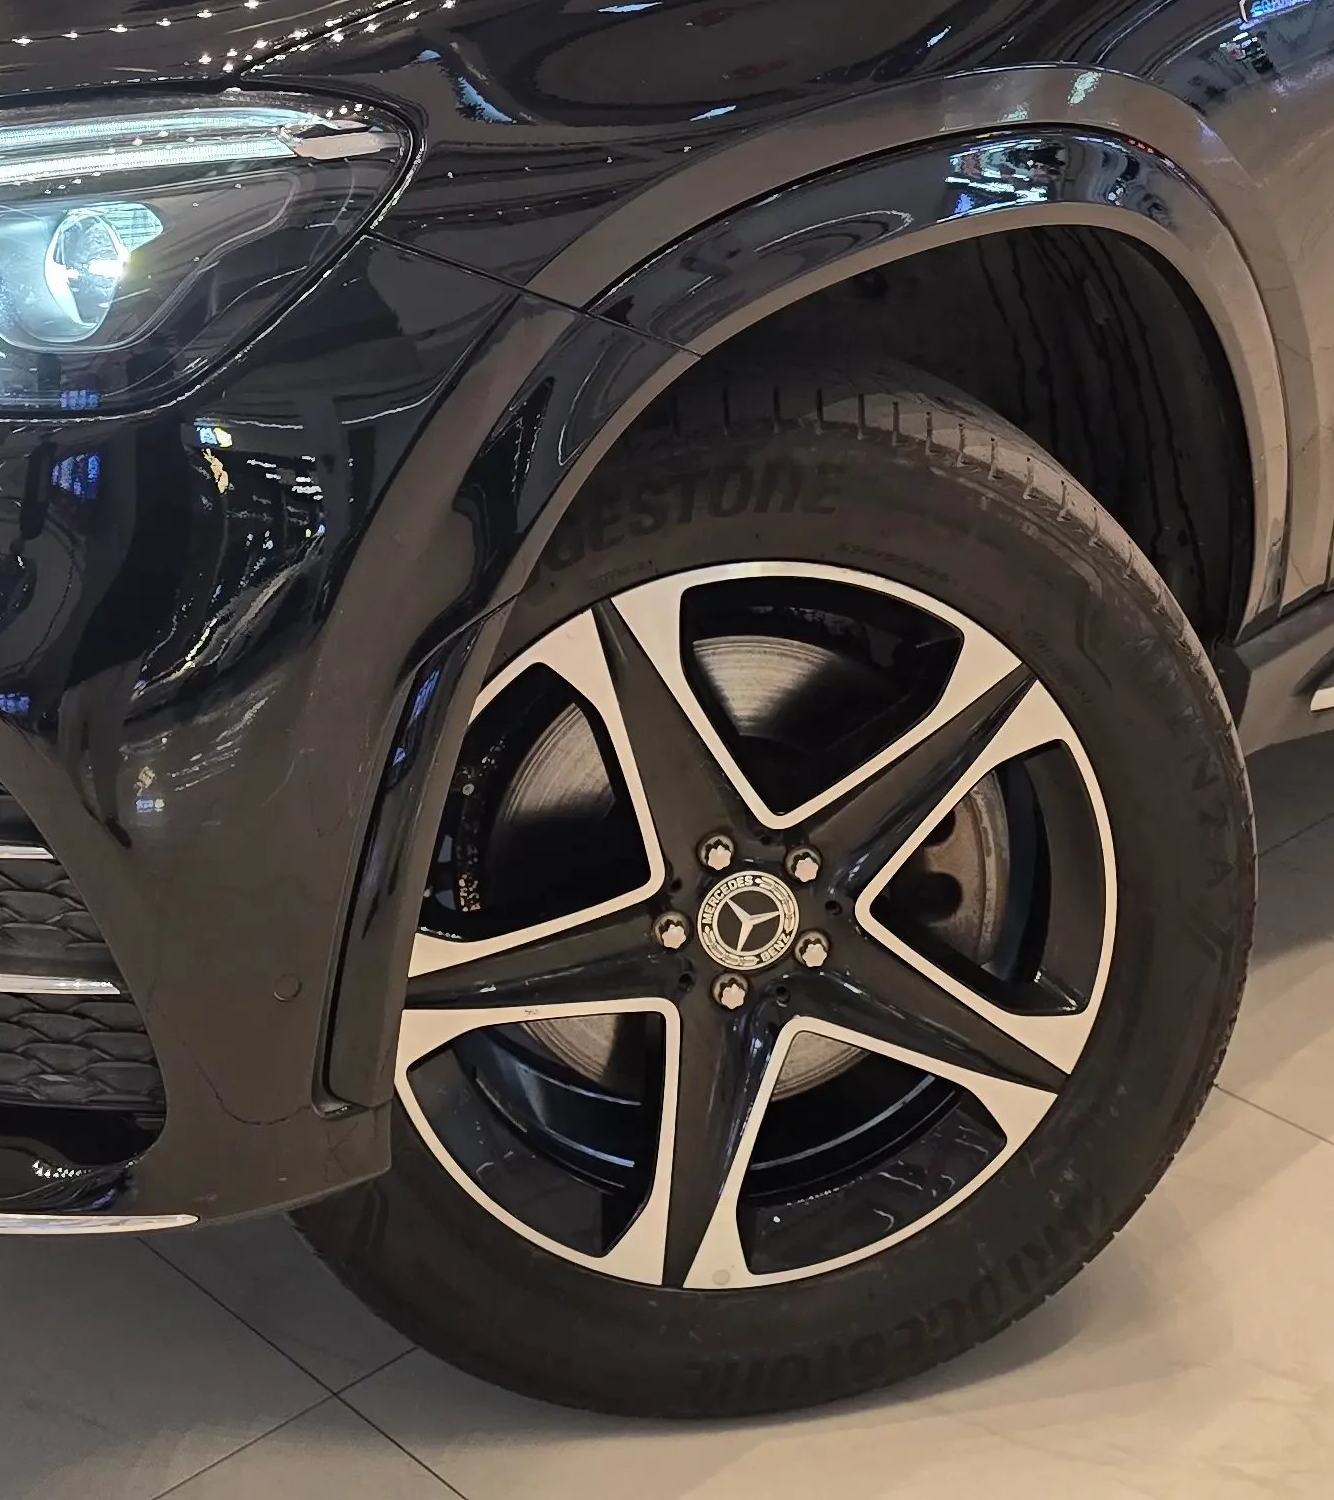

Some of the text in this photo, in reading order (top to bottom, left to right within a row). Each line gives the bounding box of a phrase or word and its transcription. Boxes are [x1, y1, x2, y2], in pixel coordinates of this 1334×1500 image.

[527, 456, 847, 582] GESTONE
[702, 875, 754, 925] MERCEDES
[760, 932, 791, 961] BENZ
